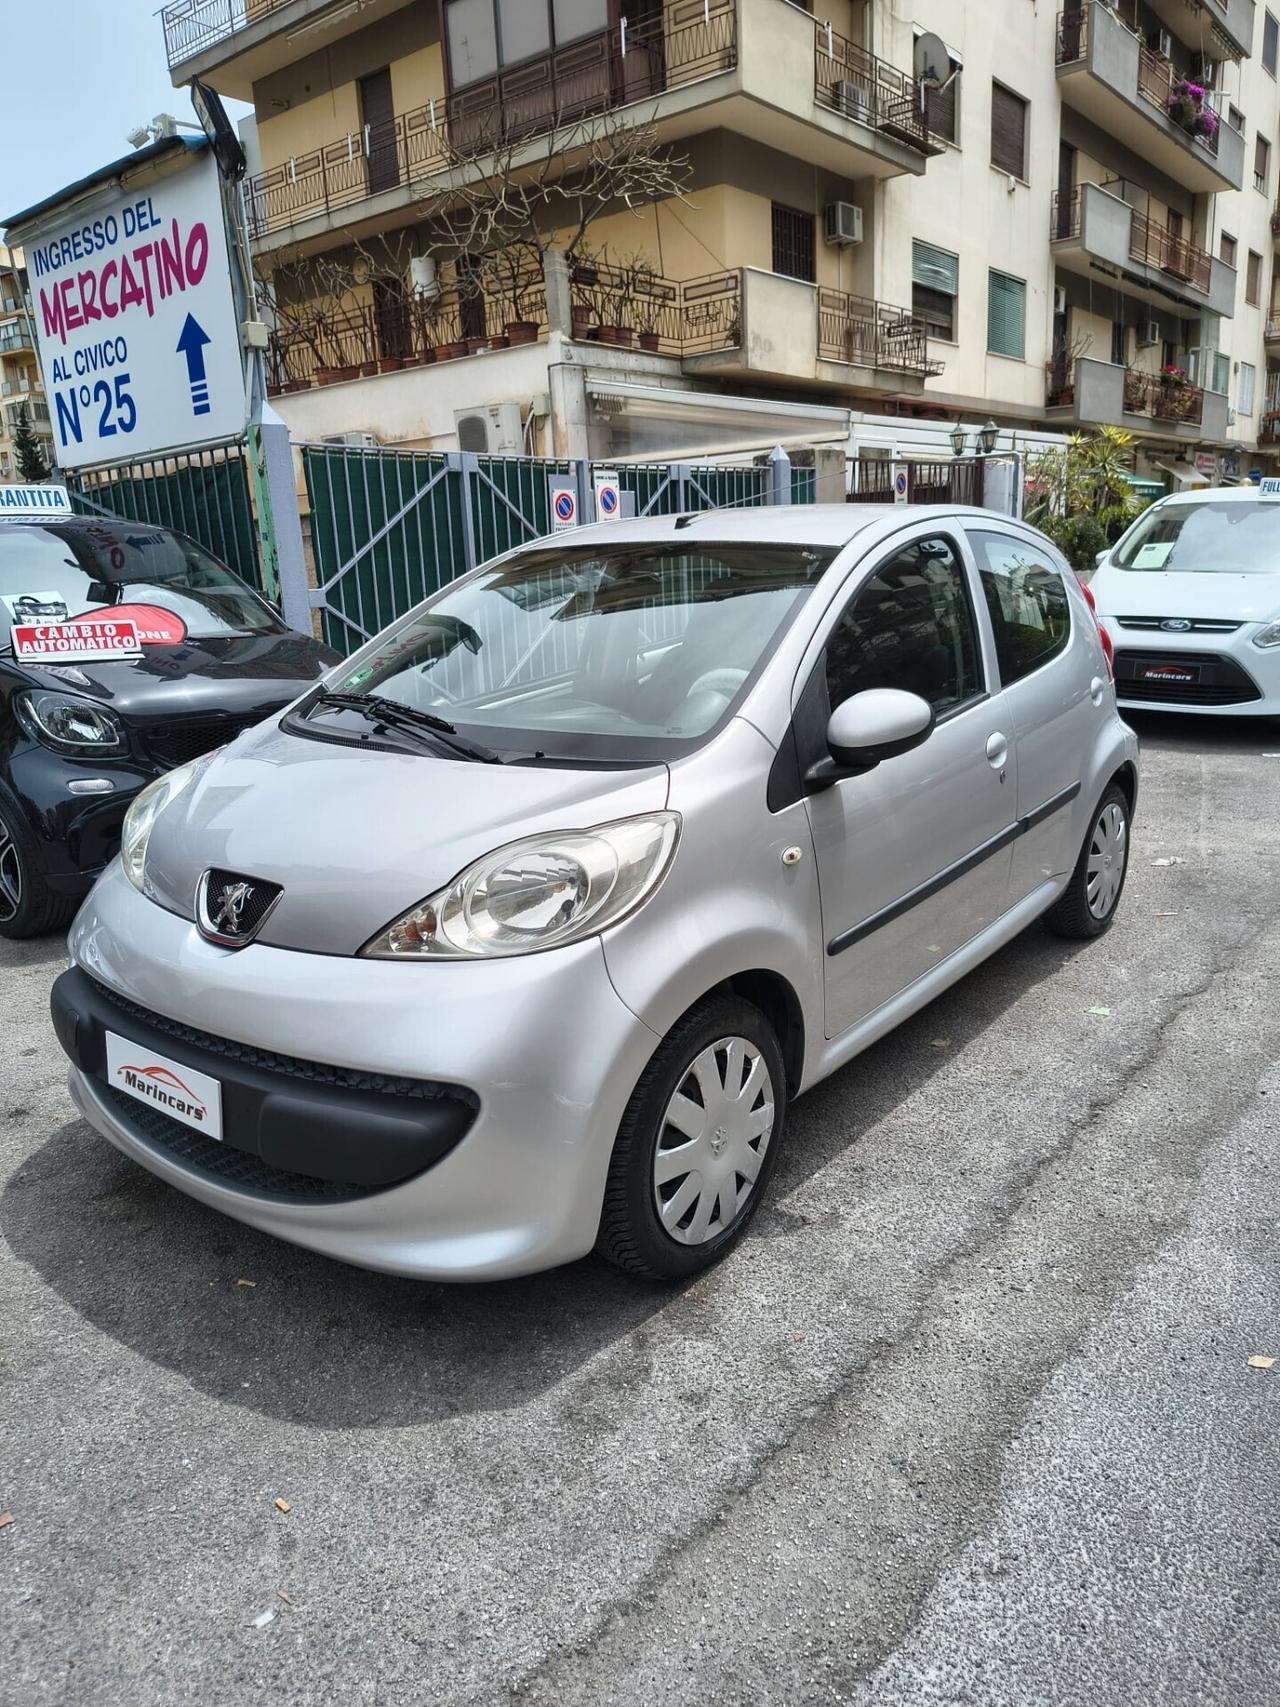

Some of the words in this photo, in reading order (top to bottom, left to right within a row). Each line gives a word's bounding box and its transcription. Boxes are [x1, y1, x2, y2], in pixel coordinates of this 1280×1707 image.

[33, 215, 118, 278] INGRESSO
[122, 197, 162, 239] DEL
[39, 218, 209, 346] MERCATINO
[52, 355, 72, 384] AL
[74, 336, 128, 377] CIVICO
[21, 636, 135, 654] AUTOMATICO
[35, 624, 117, 640] CAMBIO
[1144, 671, 1193, 681] Marincars
[124, 1070, 204, 1121] Marincars
